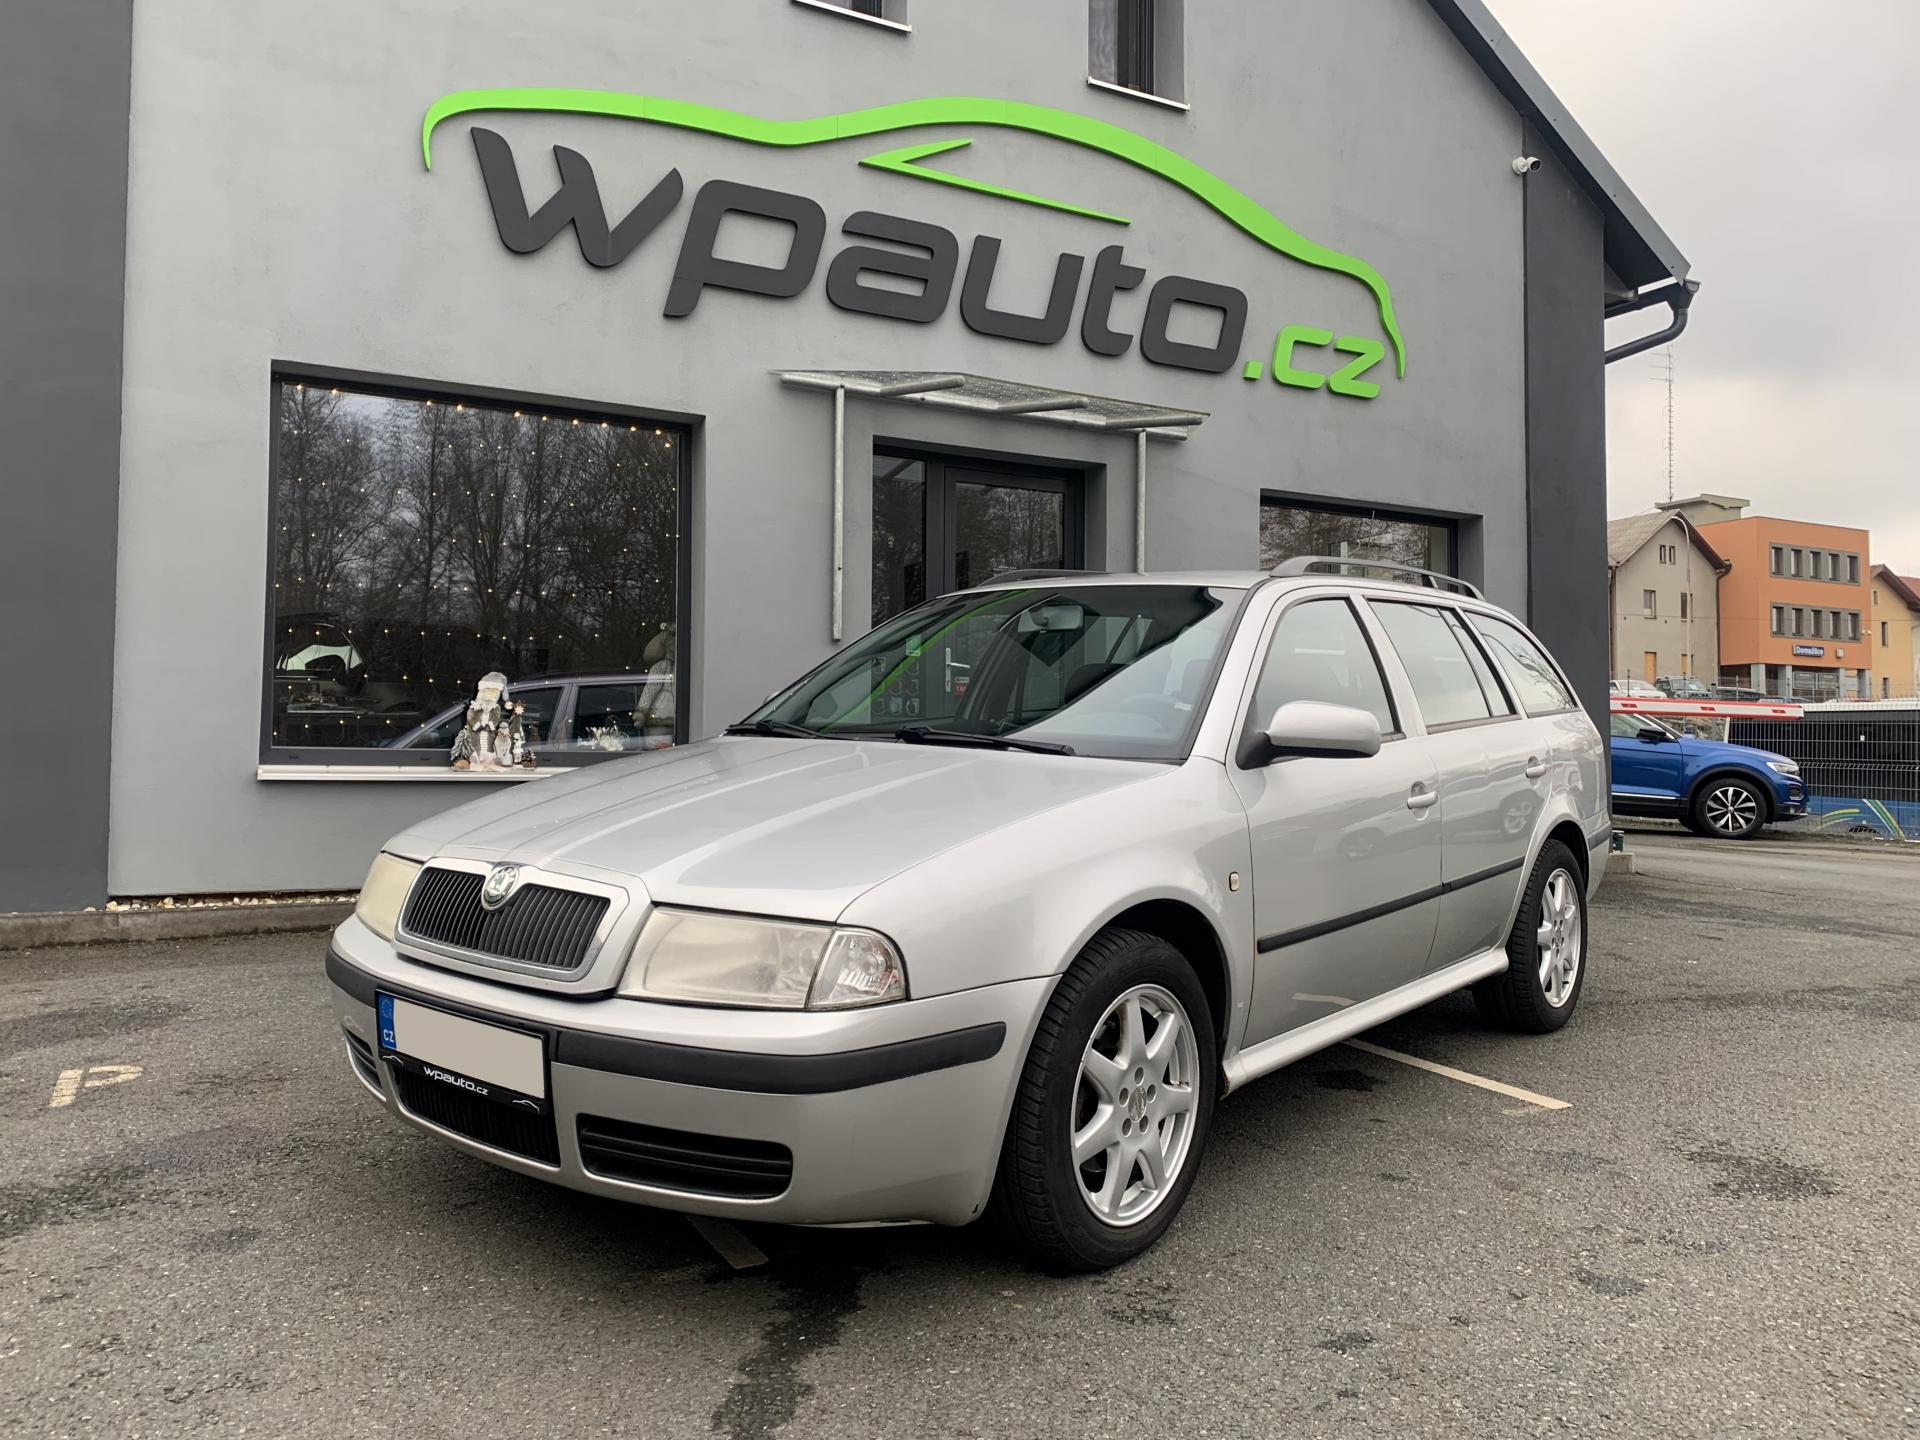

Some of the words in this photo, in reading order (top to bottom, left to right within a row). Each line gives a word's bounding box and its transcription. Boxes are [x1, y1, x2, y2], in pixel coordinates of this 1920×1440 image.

[470, 127, 1385, 399] wpauto.cz
[383, 1029, 394, 1043] CZ
[423, 1066, 489, 1096] wpauto.cz
